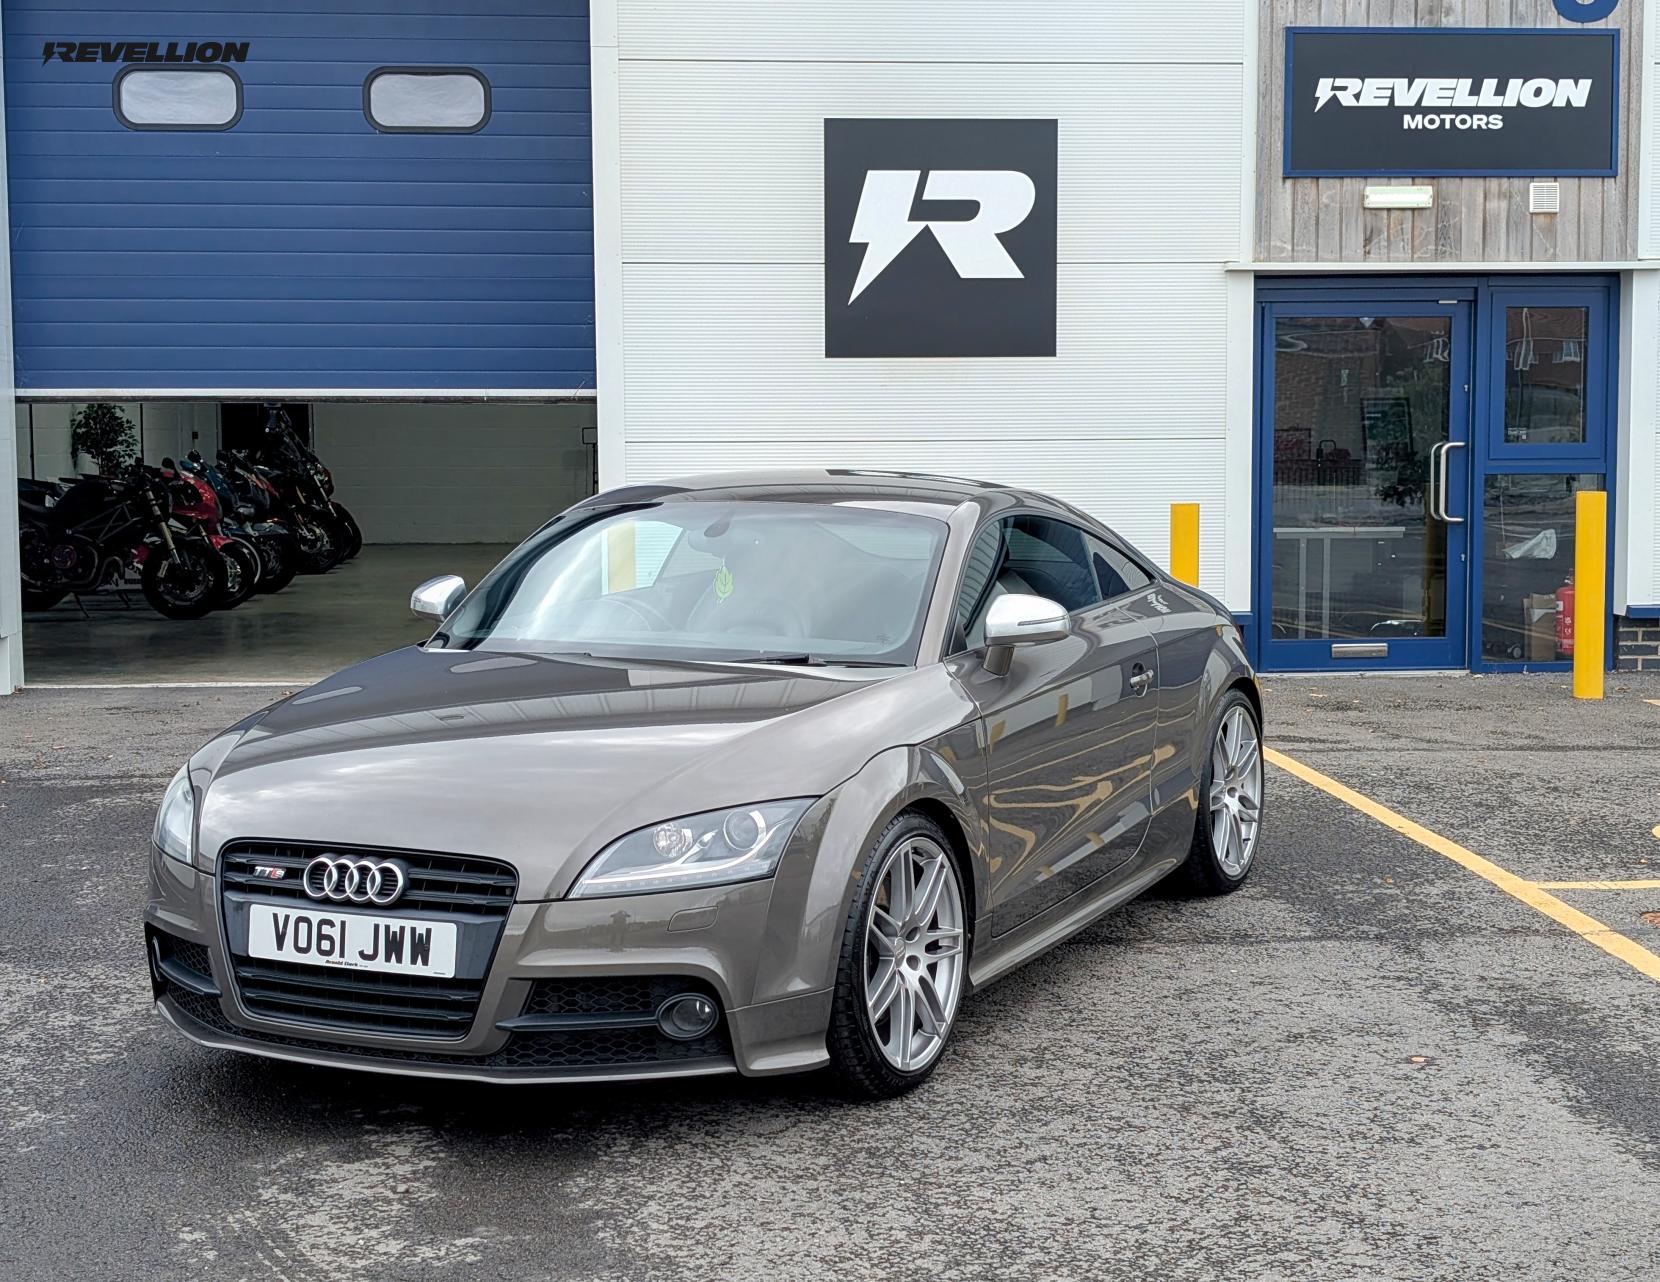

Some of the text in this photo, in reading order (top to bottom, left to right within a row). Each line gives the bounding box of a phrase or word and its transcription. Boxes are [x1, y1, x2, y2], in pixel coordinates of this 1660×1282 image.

[1314, 77, 1592, 112] REVELLION
[1403, 114, 1503, 130] MOTORS
[847, 170, 1036, 306] R
[254, 866, 286, 878] TTS
[272, 912, 432, 966] VO61 JWW
